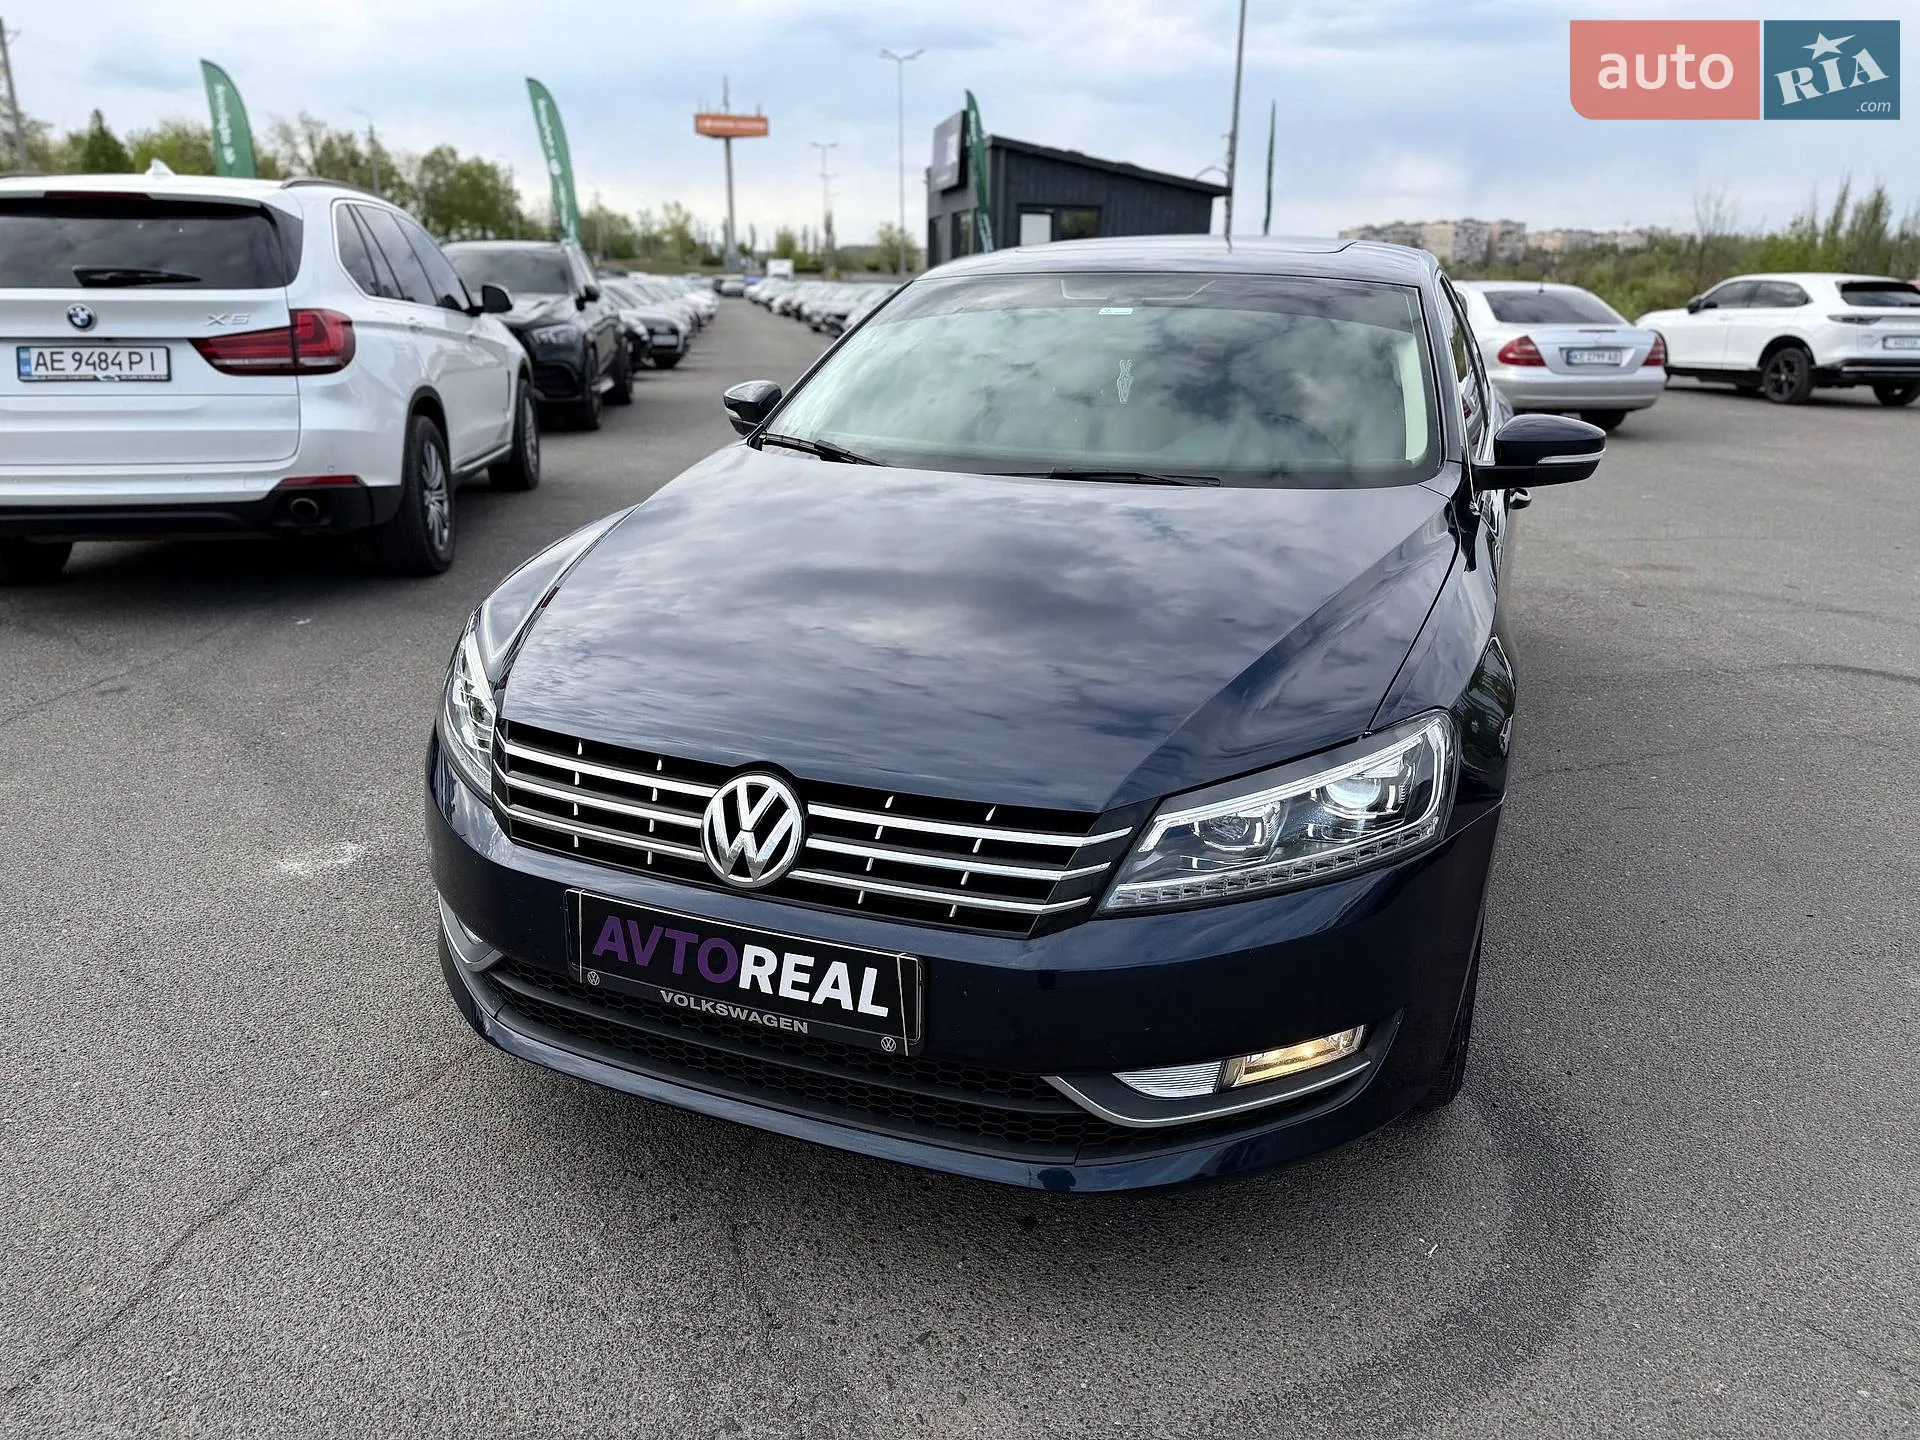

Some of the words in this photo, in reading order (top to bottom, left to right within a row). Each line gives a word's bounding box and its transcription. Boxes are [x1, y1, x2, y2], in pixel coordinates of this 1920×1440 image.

[207, 312, 250, 327] X5
[34, 351, 66, 372] AE
[71, 351, 122, 372] 9484
[592, 914, 889, 1018] AVTOREAL
[660, 990, 809, 1034] VOLKSWAGEN
